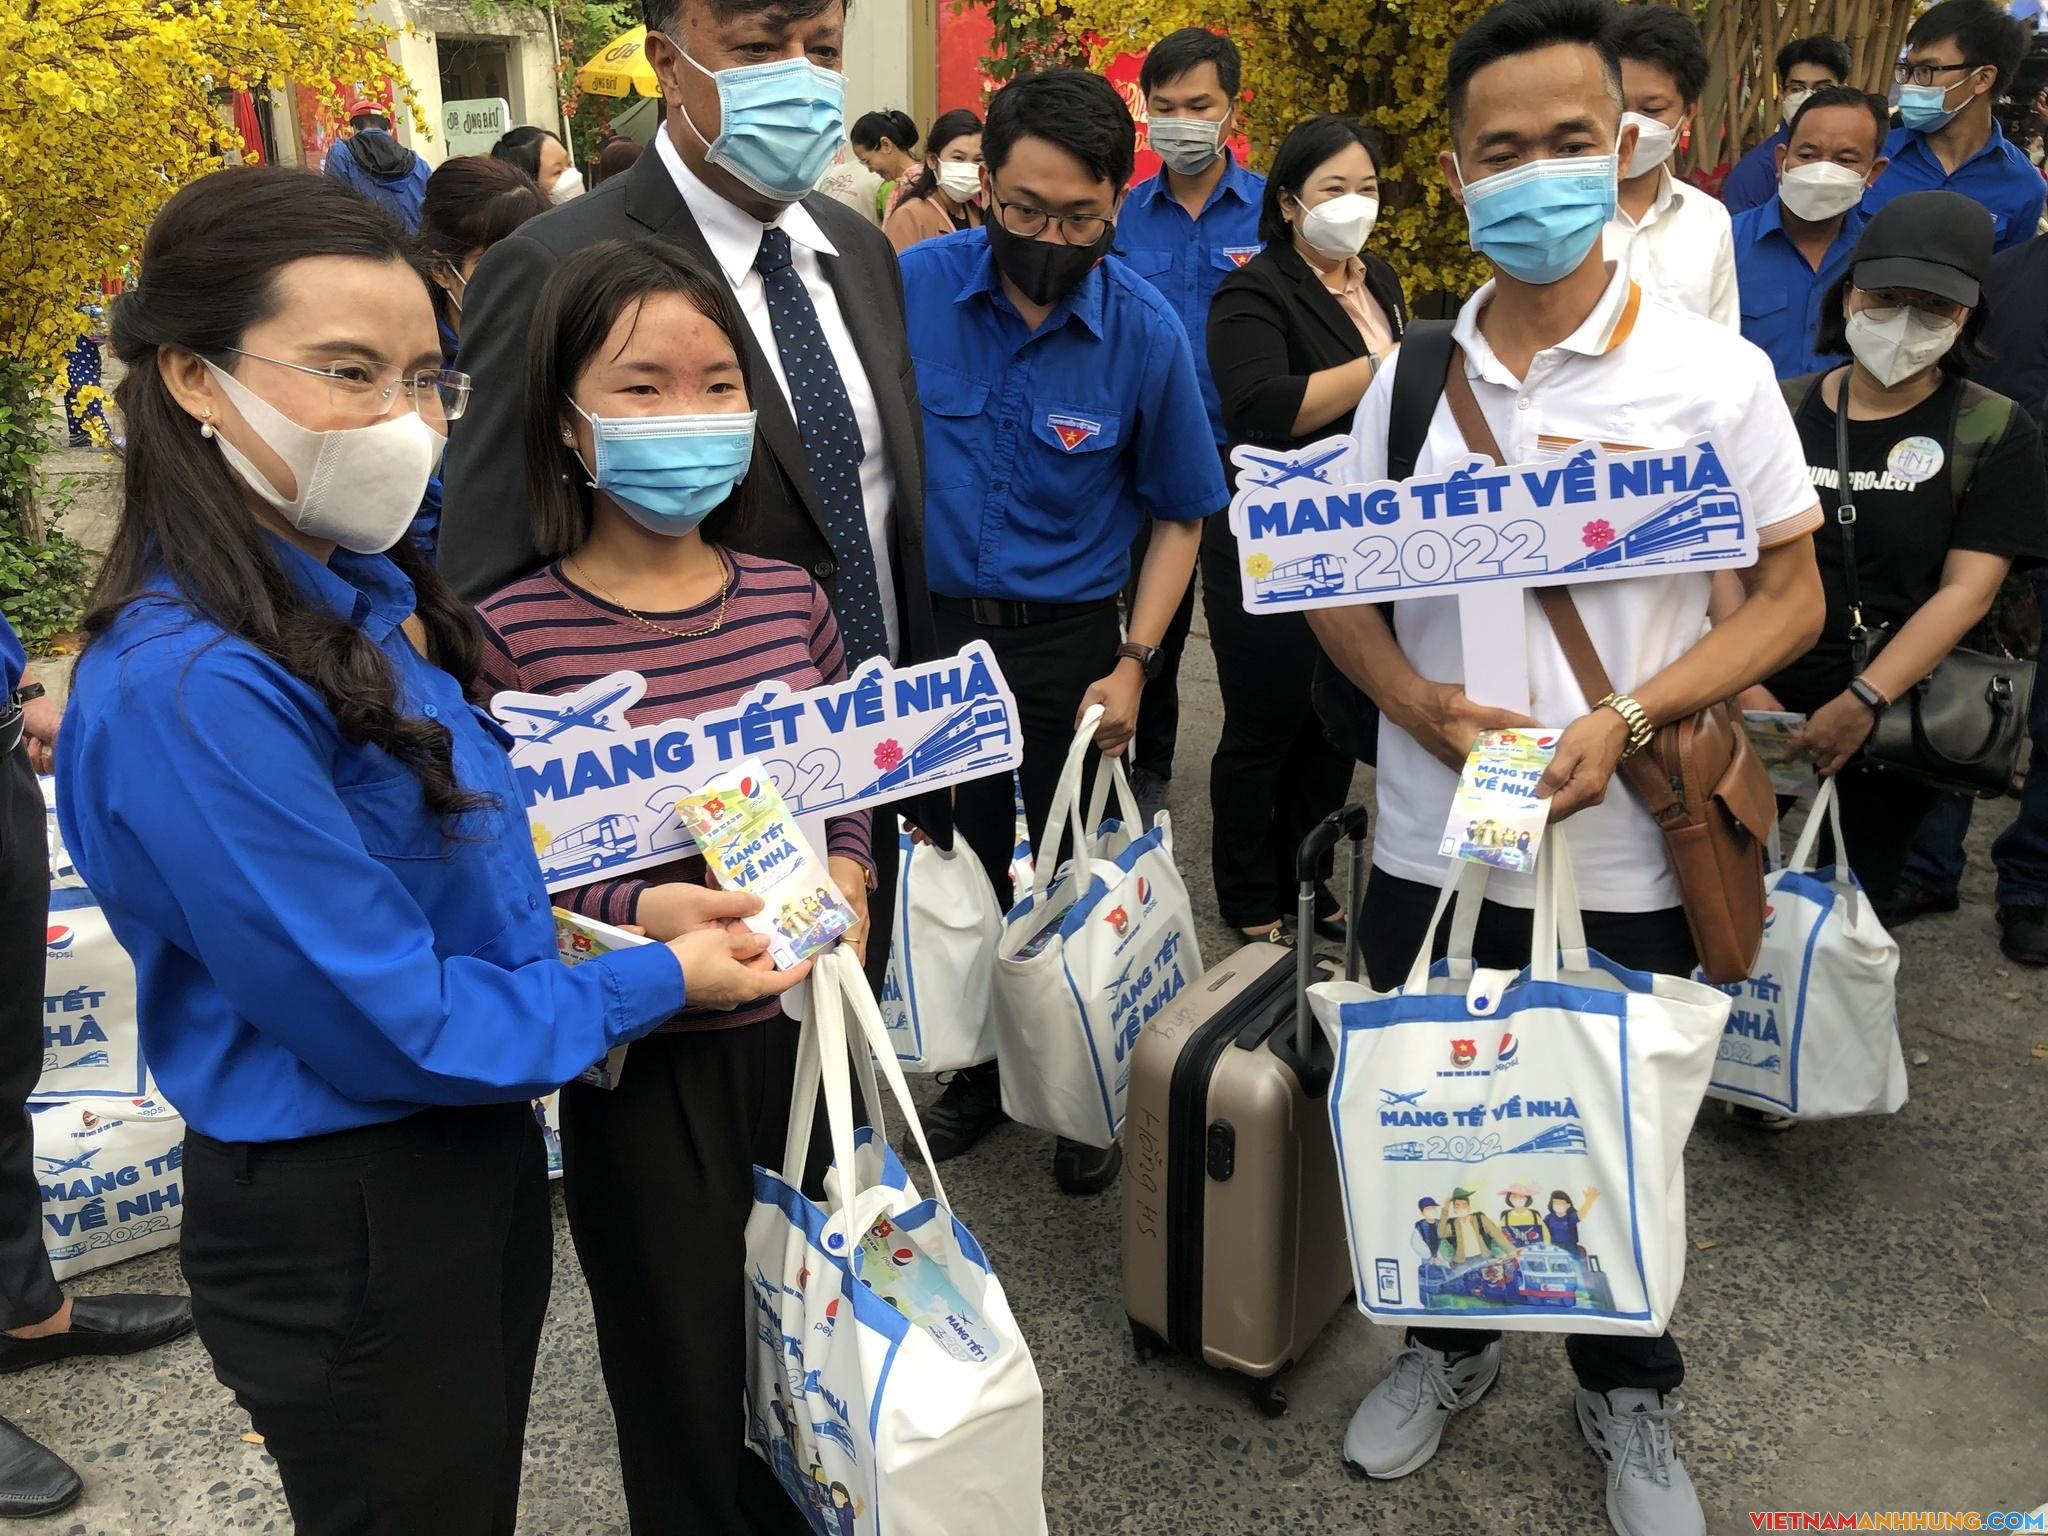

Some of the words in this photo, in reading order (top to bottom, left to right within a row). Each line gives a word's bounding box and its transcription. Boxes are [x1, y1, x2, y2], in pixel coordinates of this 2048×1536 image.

[1248, 489, 1400, 540] MANG
[1410, 463, 1510, 520] TẾT
[1521, 449, 1597, 508] VỀ
[1609, 441, 1732, 499] NHÀ
[1353, 519, 1548, 591] 2022
[515, 731, 696, 808] MANG
[704, 693, 805, 762] TẾT
[815, 668, 886, 734] VỀ
[895, 652, 999, 718] NHÀ
[1474, 776, 1499, 791] VỀ
[1477, 764, 1518, 778] MANG
[1522, 770, 1542, 782] TẾ
[645, 748, 844, 852] 222
[725, 840, 762, 871] MANG
[761, 823, 785, 844] TẾT
[733, 862, 759, 888] VỀ
[759, 839, 799, 873] NHÀ
[47, 950, 74, 960] epsi
[44, 985, 106, 1014] TẾT
[1111, 966, 1153, 1032] MANG
[1154, 931, 1181, 972] TẾT
[1748, 972, 1782, 1004] TẾT
[43, 1014, 109, 1048] HÀ
[1114, 1006, 1141, 1063] VỀ
[1143, 961, 1186, 1024] NHÀ
[1724, 1008, 1782, 1047] NHÀ
[1381, 1110, 1449, 1127] MANG
[1492, 1095, 1522, 1121] VỀ
[1527, 1097, 1581, 1119] NHÀ
[1426, 1132, 1502, 1160] 2022
[40, 1166, 141, 1203] MANG
[145, 1141, 184, 1177] TẾ
[116, 1182, 183, 1223] NH
[89, 1216, 170, 1250] 2022
[945, 1315, 971, 1341] MANG
[966, 1339, 986, 1357] TẾT
